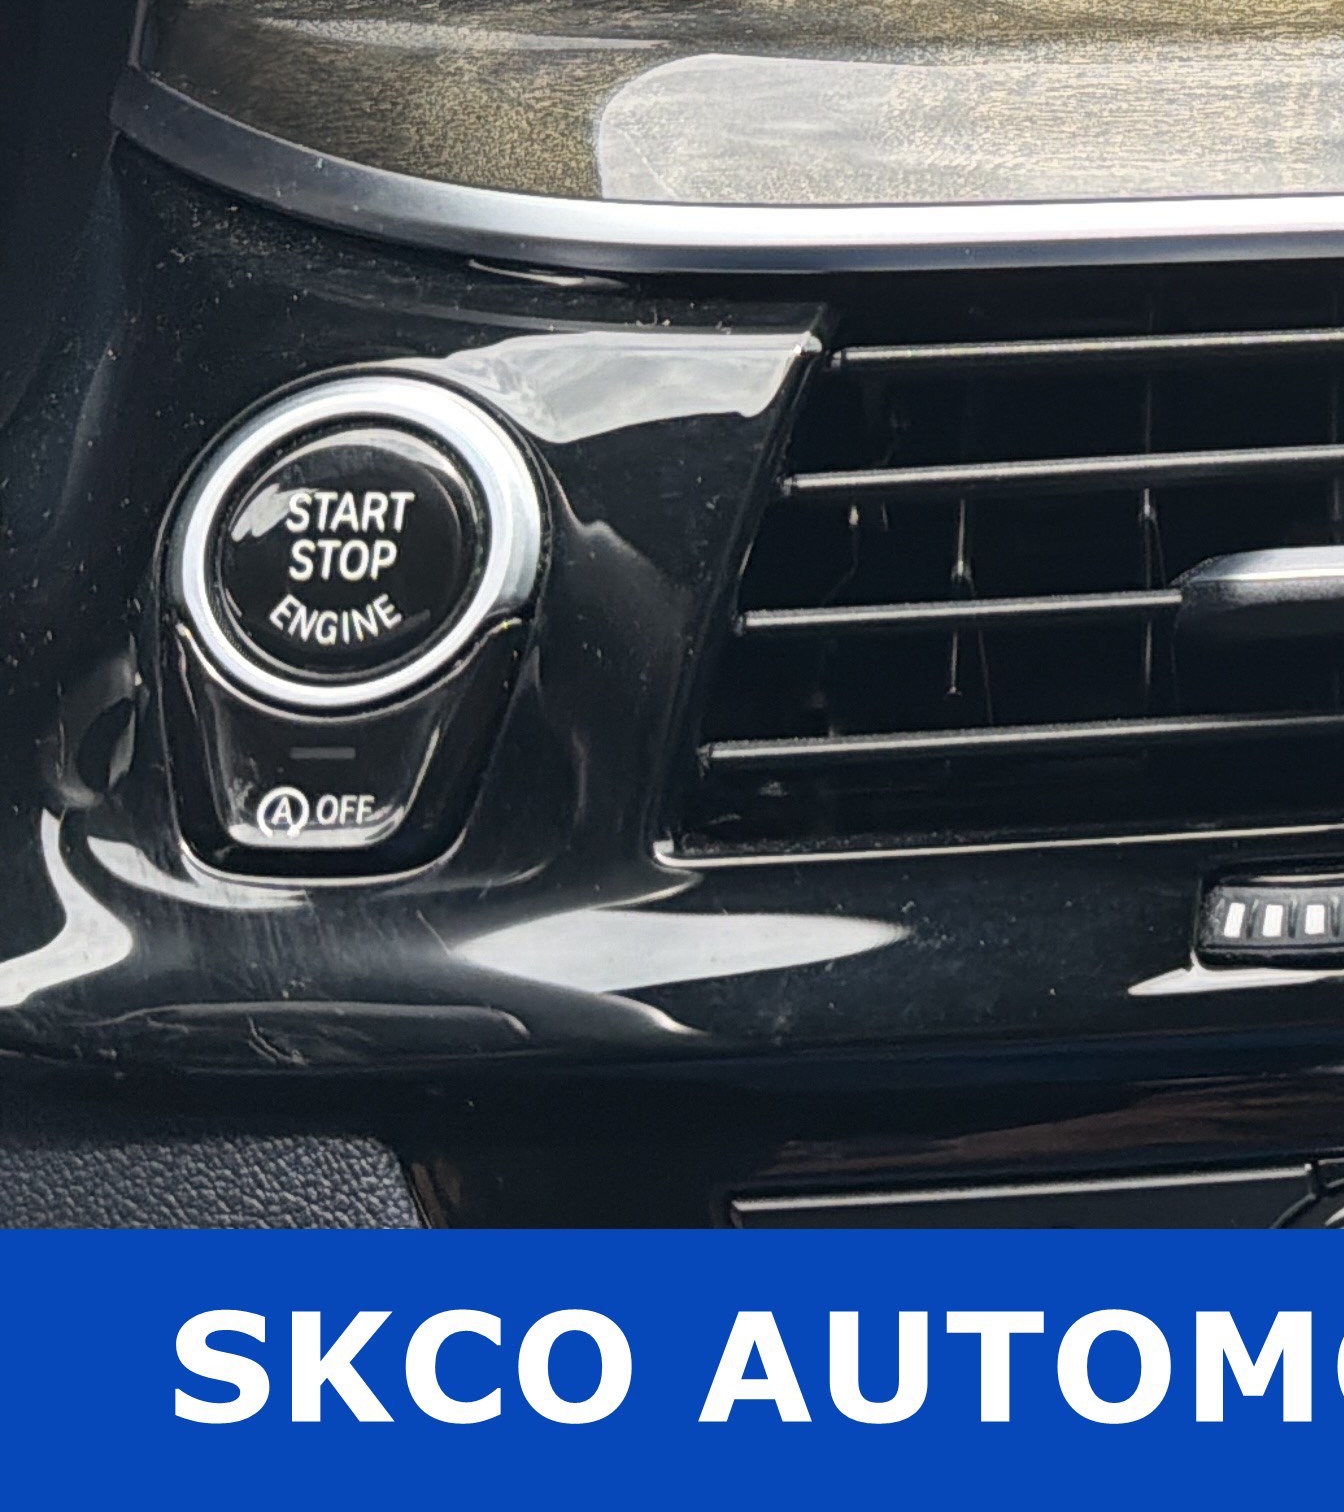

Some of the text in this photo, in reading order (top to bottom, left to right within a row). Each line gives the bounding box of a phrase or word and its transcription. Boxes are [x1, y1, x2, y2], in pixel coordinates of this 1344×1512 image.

[286, 491, 415, 533] START
[289, 539, 397, 581] STOP
[269, 594, 404, 646] ENGINE
[316, 795, 374, 825] OFF
